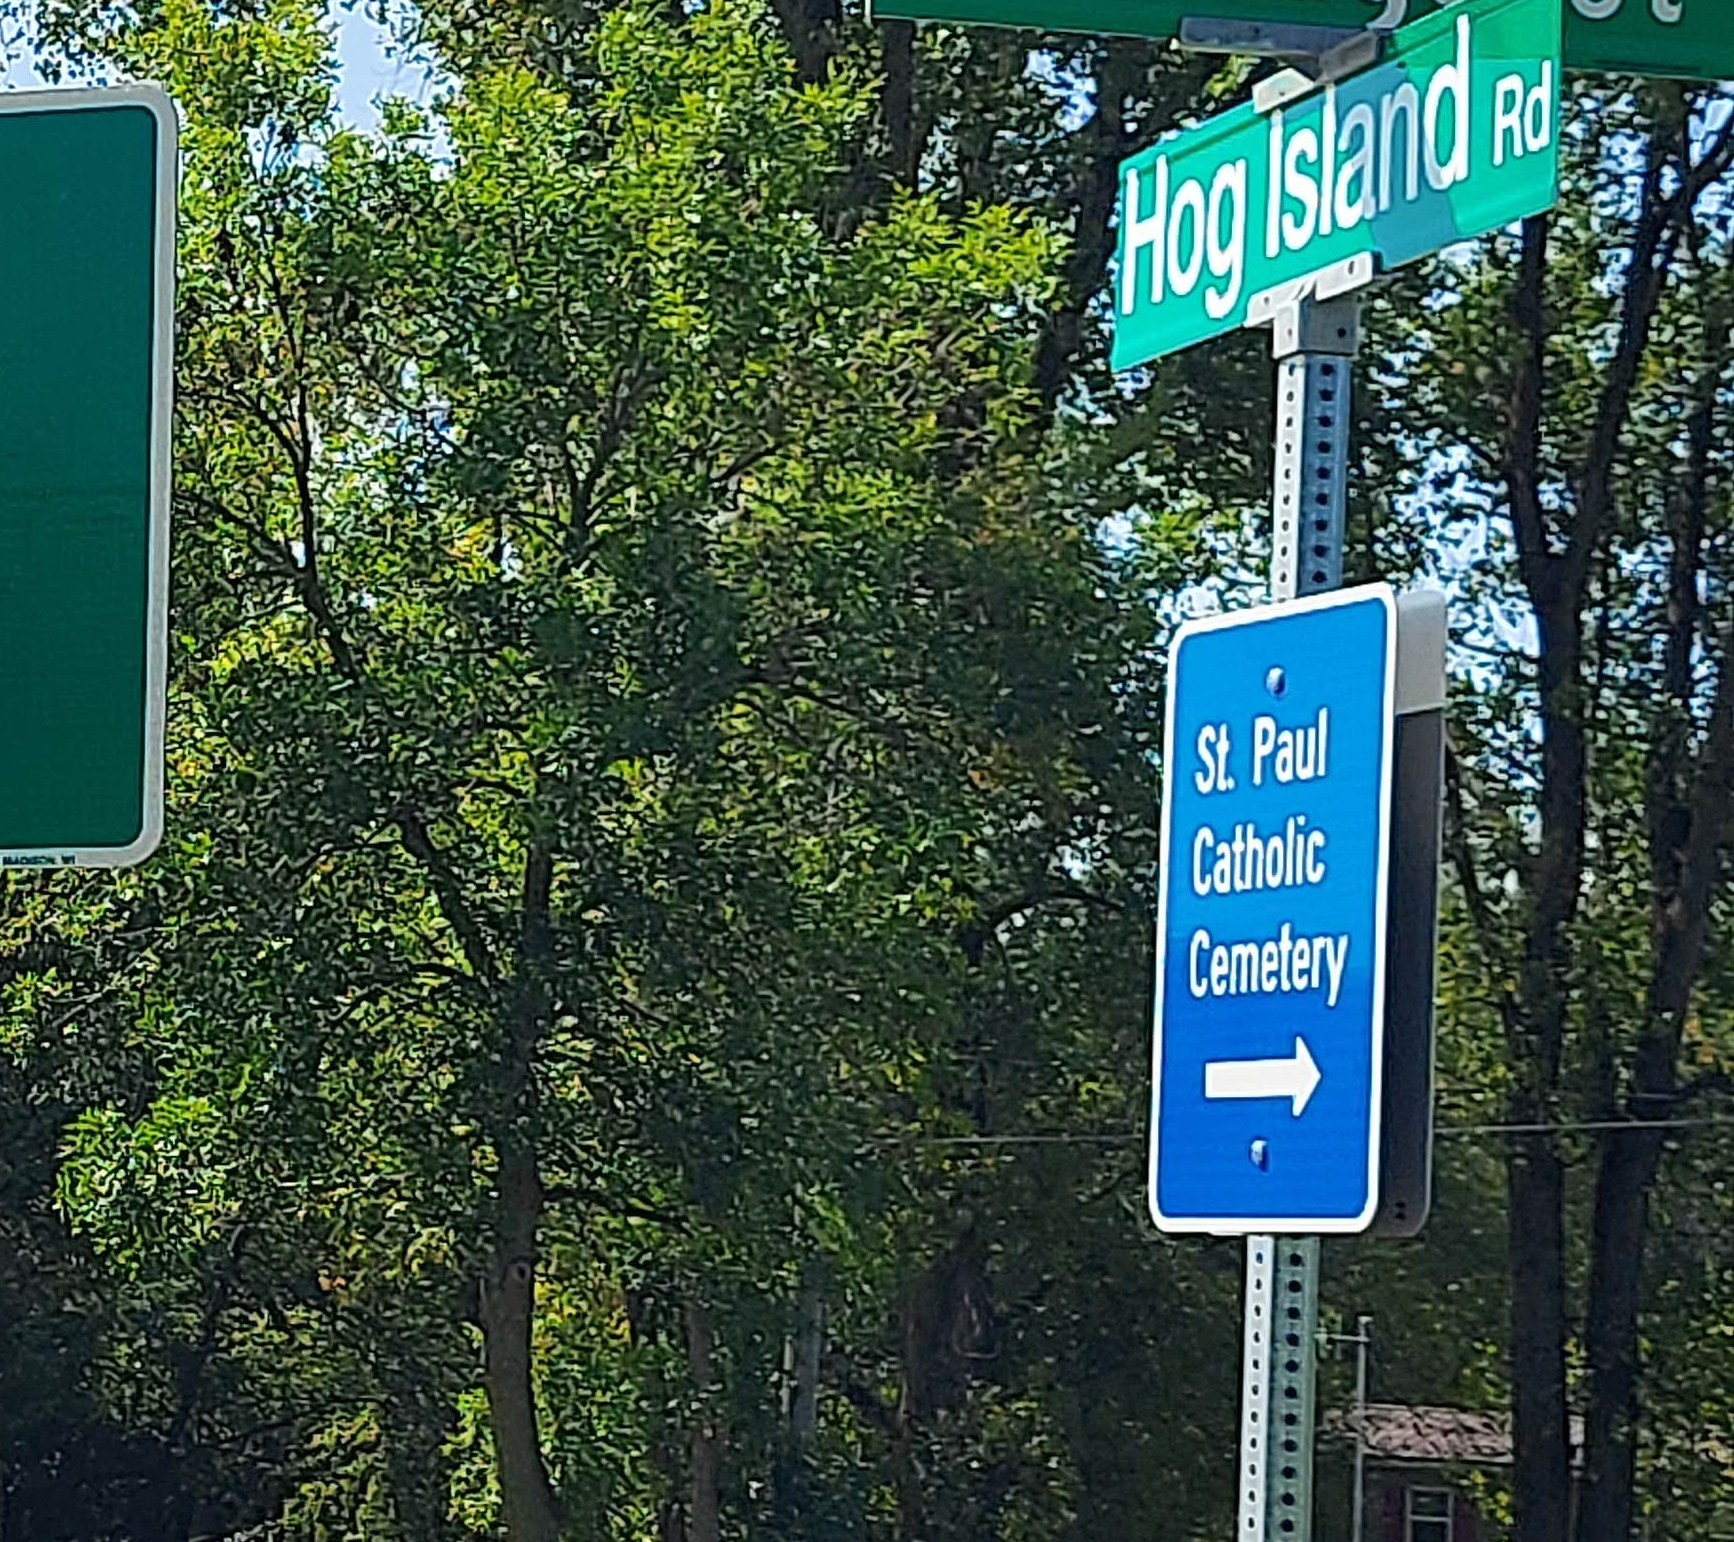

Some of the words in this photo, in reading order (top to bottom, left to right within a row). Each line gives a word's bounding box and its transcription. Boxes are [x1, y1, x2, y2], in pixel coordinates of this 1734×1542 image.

[1120, 153, 1247, 319] Hog
[1265, 13, 1470, 258] Island
[1492, 59, 1552, 167] Rd
[1194, 723, 1235, 795] St.
[1251, 706, 1328, 788] Paul
[1192, 815, 1326, 896] Catholic
[1188, 922, 1349, 1007] Cemetery
